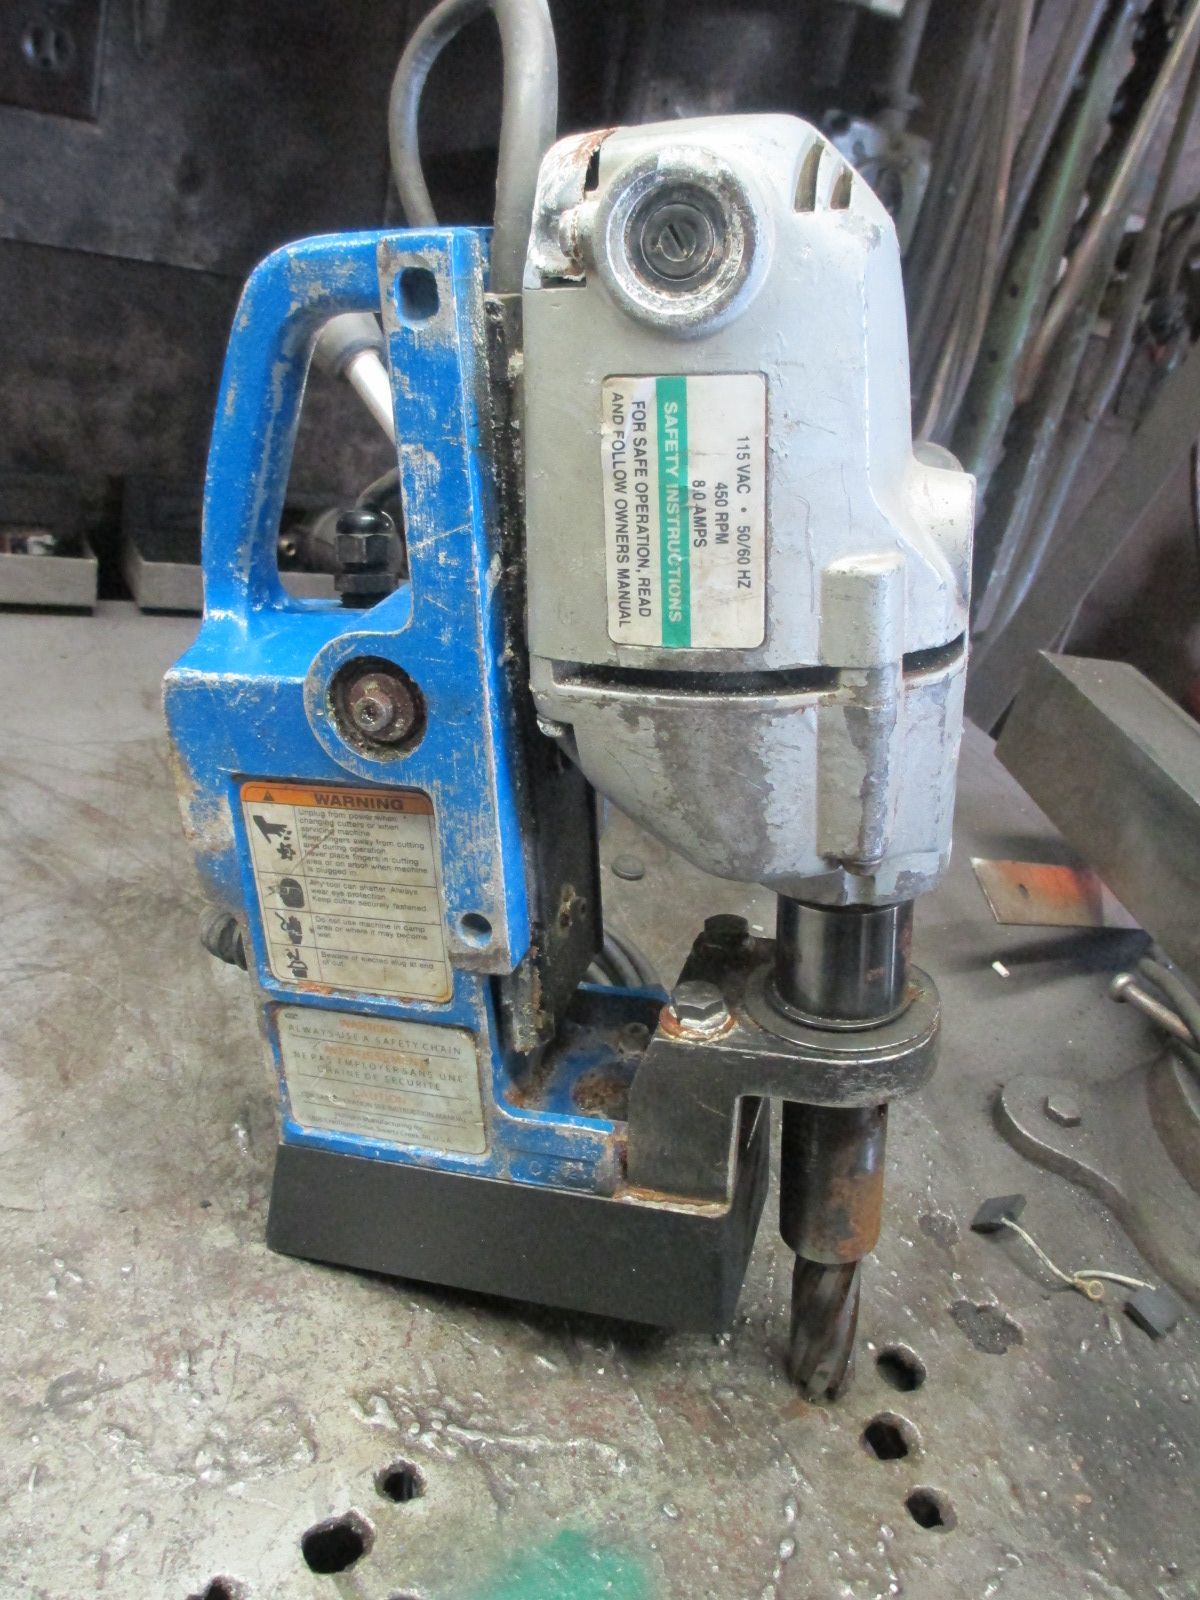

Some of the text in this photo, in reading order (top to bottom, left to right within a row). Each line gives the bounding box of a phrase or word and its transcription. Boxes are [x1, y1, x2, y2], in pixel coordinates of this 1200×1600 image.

[611, 392, 631, 628] AND FOLLOW OWNERS MANUAL
[632, 401, 651, 617] FOR SAFE OPERATION, READ
[664, 402, 682, 622] SAFETY INSTRUCTIONS
[692, 480, 707, 548] 8.0 AMPS
[715, 482, 729, 544] 450 RPM
[736, 436, 751, 589] 115 VAC 50/60 HZ
[314, 793, 404, 810] WARNING
[300, 808, 326, 819] Unplug
[328, 811, 345, 819] from
[349, 813, 372, 822] power
[300, 817, 334, 828] changing
[337, 820, 364, 828] cutters
[379, 823, 398, 831] when
[301, 826, 334, 836] servicing
[302, 834, 322, 844] Keep
[353, 839, 373, 848] away
[376, 840, 393, 848] from
[397, 841, 425, 851] cutting
[323, 843, 347, 854] during
[305, 850, 328, 858] Never
[329, 852, 350, 861] place
[353, 853, 379, 864] fingers
[391, 857, 419, 867] cutting
[316, 867, 347, 876] plugged
[371, 864, 392, 872] when
[394, 865, 428, 874] machine
[310, 879, 325, 889] Any
[327, 881, 341, 889] tool
[391, 886, 418, 897] Always
[312, 888, 328, 896] wear
[331, 890, 345, 899] eye
[312, 895, 330, 905] Keep
[333, 897, 355, 905] cutter
[358, 899, 390, 910] securely
[315, 915, 425, 934] Do not use machine in damp
[317, 924, 333, 932] area
[346, 927, 369, 936] where
[378, 930, 394, 939] may
[396, 931, 428, 941] become
[321, 951, 349, 960] Beware
[391, 957, 407, 968] slug
[419, 961, 434, 970] end
[288, 1023, 334, 1039] ALWAYS
[362, 1034, 370, 1043] A
[375, 1037, 418, 1050] SAFETY
[422, 1043, 461, 1056] CHAIN
[439, 1073, 463, 1084] UNE
